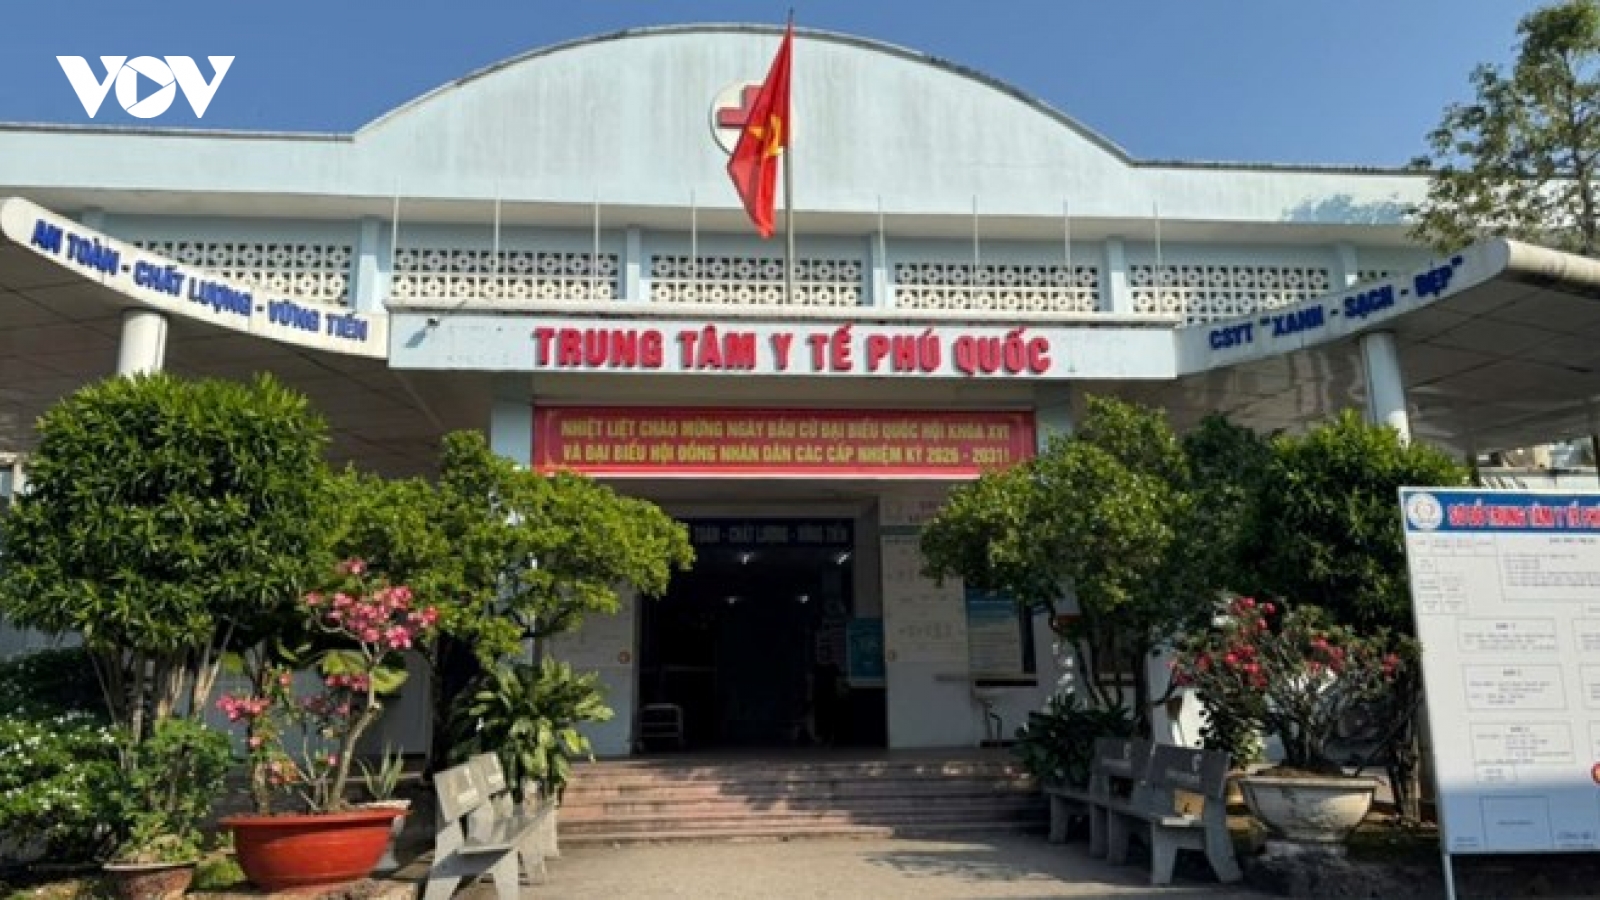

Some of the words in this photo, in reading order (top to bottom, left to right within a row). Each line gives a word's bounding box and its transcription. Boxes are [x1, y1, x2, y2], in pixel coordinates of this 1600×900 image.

[31, 219, 63, 254] AN
[67, 233, 120, 276] TOÀN
[133, 260, 185, 297] CHẤT
[187, 277, 252, 316] LƯỢNG
[268, 299, 319, 333] VỮNG
[325, 313, 367, 343] TIẾN
[1209, 323, 1253, 350] CSYT
[1344, 285, 1394, 319] SẠCH
[531, 326, 664, 368] TRUNG
[676, 323, 757, 370] TÂM
[769, 332, 794, 371] Y
[806, 322, 853, 372] TẾ
[865, 327, 941, 373] PHÚ
[952, 326, 1051, 376] QUỐC
[561, 418, 600, 437] NHIỆT
[607, 418, 635, 437] LIỆT
[639, 419, 676, 437] CHÀO
[727, 419, 763, 438] NGÀY
